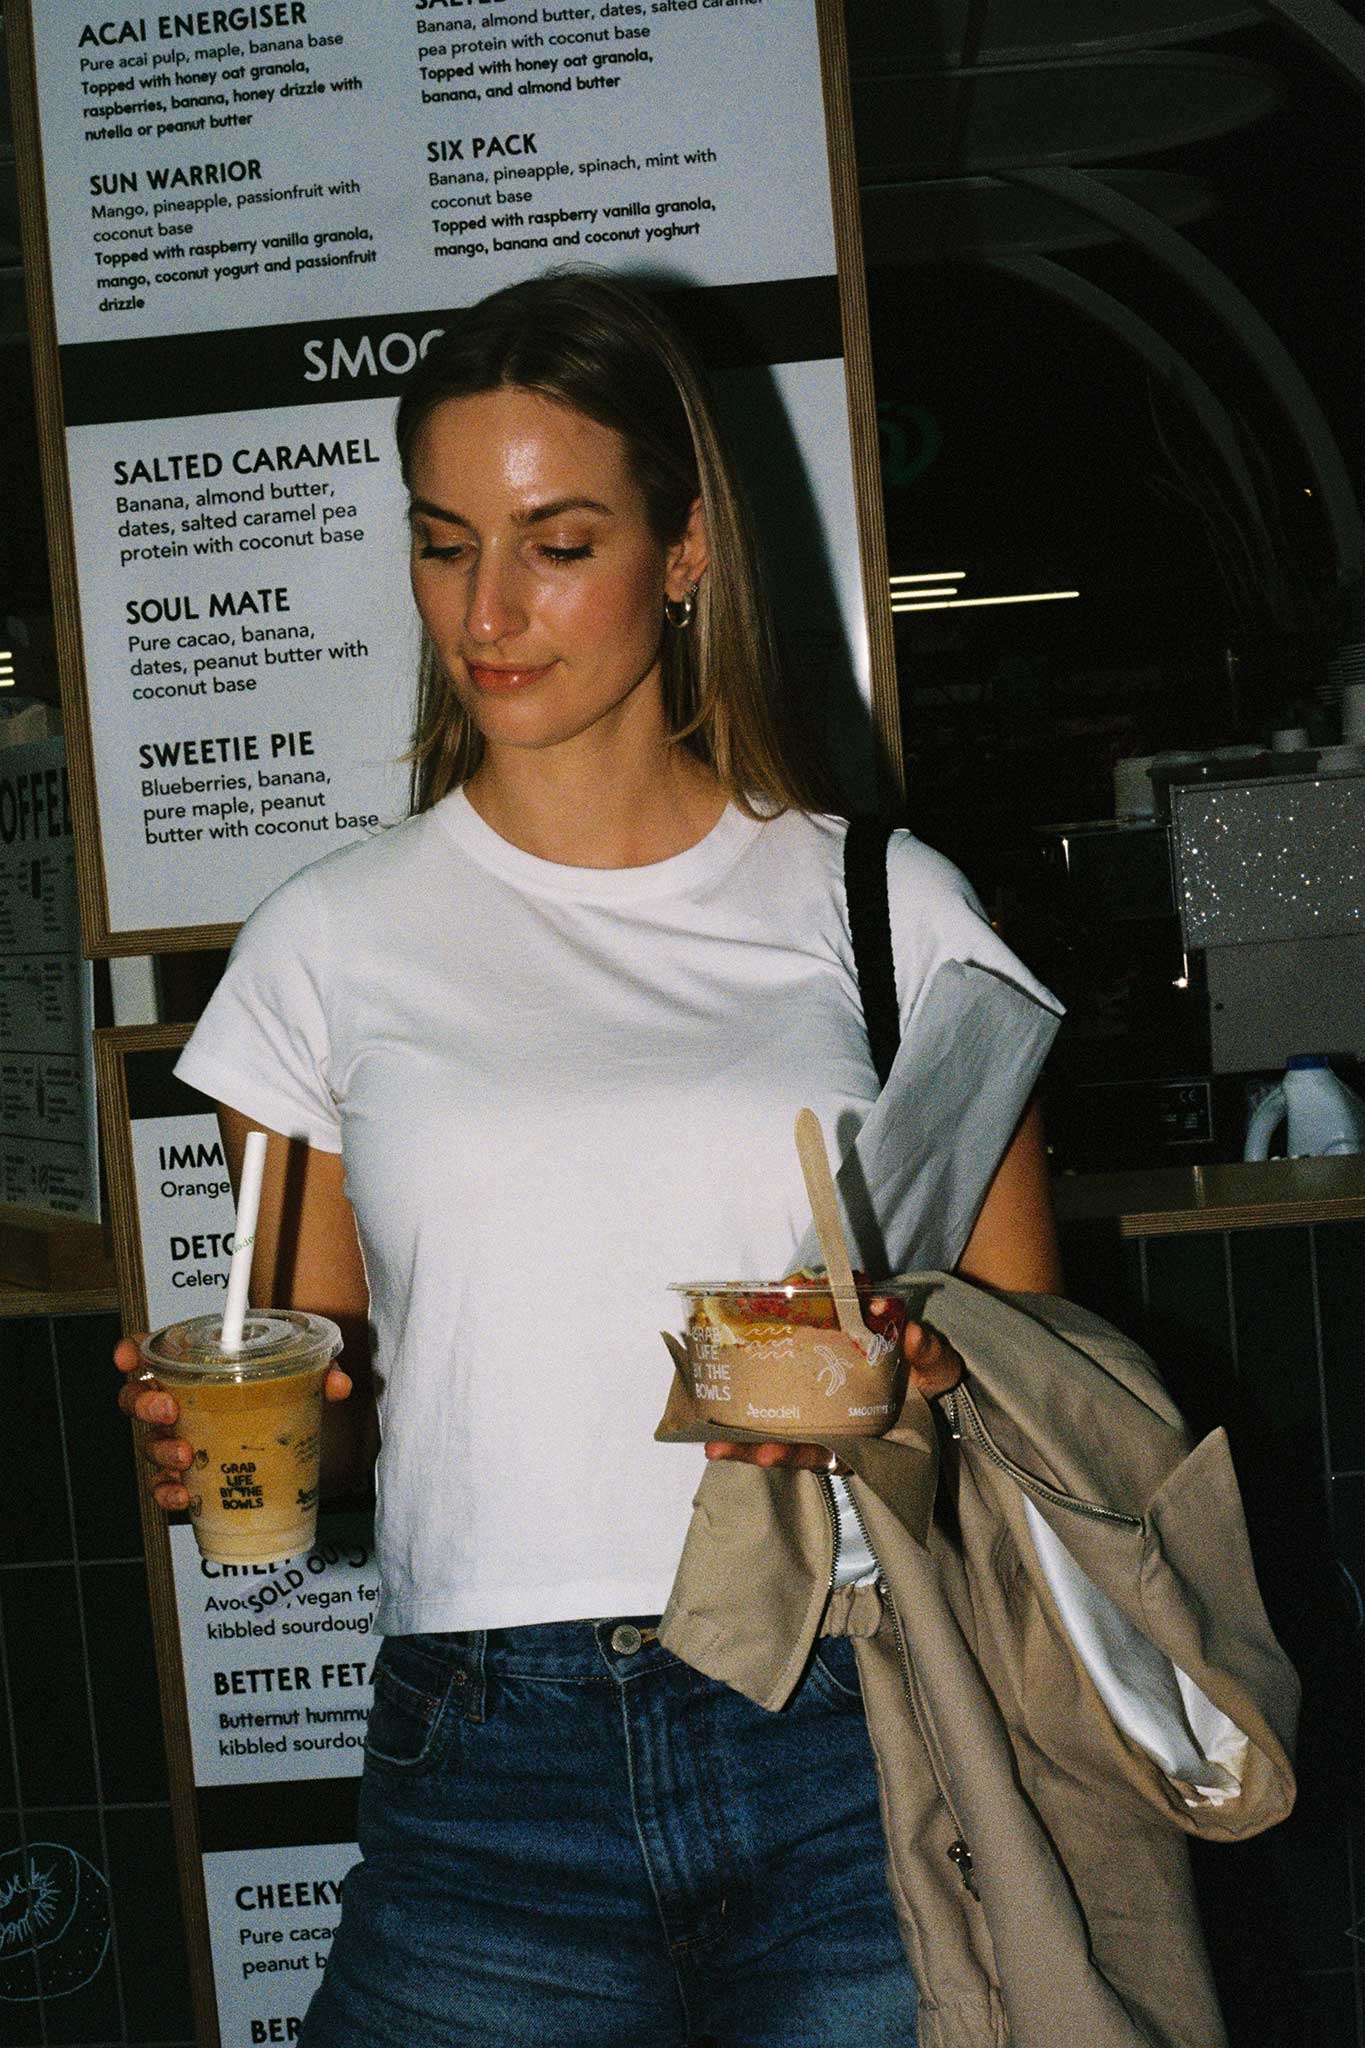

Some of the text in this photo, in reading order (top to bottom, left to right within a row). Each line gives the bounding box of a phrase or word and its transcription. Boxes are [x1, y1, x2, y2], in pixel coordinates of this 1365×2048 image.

[78, 1, 307, 48] ACAI ENERGISER
[416, 19, 476, 34] Banana,
[481, 9, 538, 28] almond
[542, 8, 595, 22] butter,
[600, 3, 646, 18] dates,
[651, 0, 698, 13] salted
[80, 33, 343, 72] Pure acai pulp, maple, banana base
[418, 25, 651, 62] pea protein with coconut base
[81, 59, 310, 97] Topped with honey oat granola,
[419, 48, 653, 83] Topped with honey oat granola,
[83, 76, 363, 120] raspberries, banana, honey drizzle with
[421, 76, 621, 104] banana, and almond butter
[85, 114, 253, 141] nutella or peanut butter
[427, 133, 537, 163] SIX PACK
[90, 159, 262, 196] SUN WARRIOR
[428, 148, 717, 187] Banana, pineapple, spinach, mint with
[91, 179, 360, 220] Mango, pineapple, passionfruit with
[430, 190, 533, 210] coconut base
[432, 196, 716, 236] Topped with raspberry vanilla granola,
[93, 222, 193, 243] coconut base
[94, 226, 373, 268] Topped with raspberry vanilla granola,
[434, 222, 700, 258] mango, banana and coconut yoghurt
[97, 250, 377, 290] mango, coconut yogurt and passionfruit
[98, 295, 145, 312] drizzle
[114, 439, 380, 486] SALTED CARAMEL
[116, 482, 334, 514] Banana, almond butter,
[118, 503, 357, 538] dates, salted caramel pea
[120, 527, 364, 567] protein with coconut base
[126, 587, 290, 625] SOUL MATE
[128, 625, 315, 653] Pure cacao, banana,
[130, 640, 368, 677] dates, peanut butter with
[132, 676, 257, 700] coconut base
[139, 731, 314, 769] SWEETIE PIE
[141, 770, 331, 797] Blueberries, banana,
[143, 792, 326, 827] pure maple, peanut
[144, 812, 379, 845] butter with coconut base
[159, 1142, 225, 1171] IMM
[161, 1180, 231, 1198] Orange
[172, 1270, 230, 1289] Celery
[695, 1344, 719, 1360] LIFE
[705, 1363, 731, 1380] THE
[695, 1382, 732, 1401] BOWLS
[221, 1462, 256, 1474] GRAB
[226, 1475, 254, 1487] LIFE
[220, 1486, 263, 1498] BY THE
[222, 1498, 264, 1510] BOWLS
[248, 1569, 304, 1613] SOLD
[296, 1591, 352, 1609] vegan
[207, 1619, 276, 1639] kibbled
[214, 1667, 311, 1696] BETTER
[219, 1710, 300, 1730] Butternut
[219, 1735, 287, 1756] kibbled
[235, 1881, 343, 1911] CHEEKY
[239, 1928, 284, 1946] Pure
[242, 1955, 310, 1980] peanut
